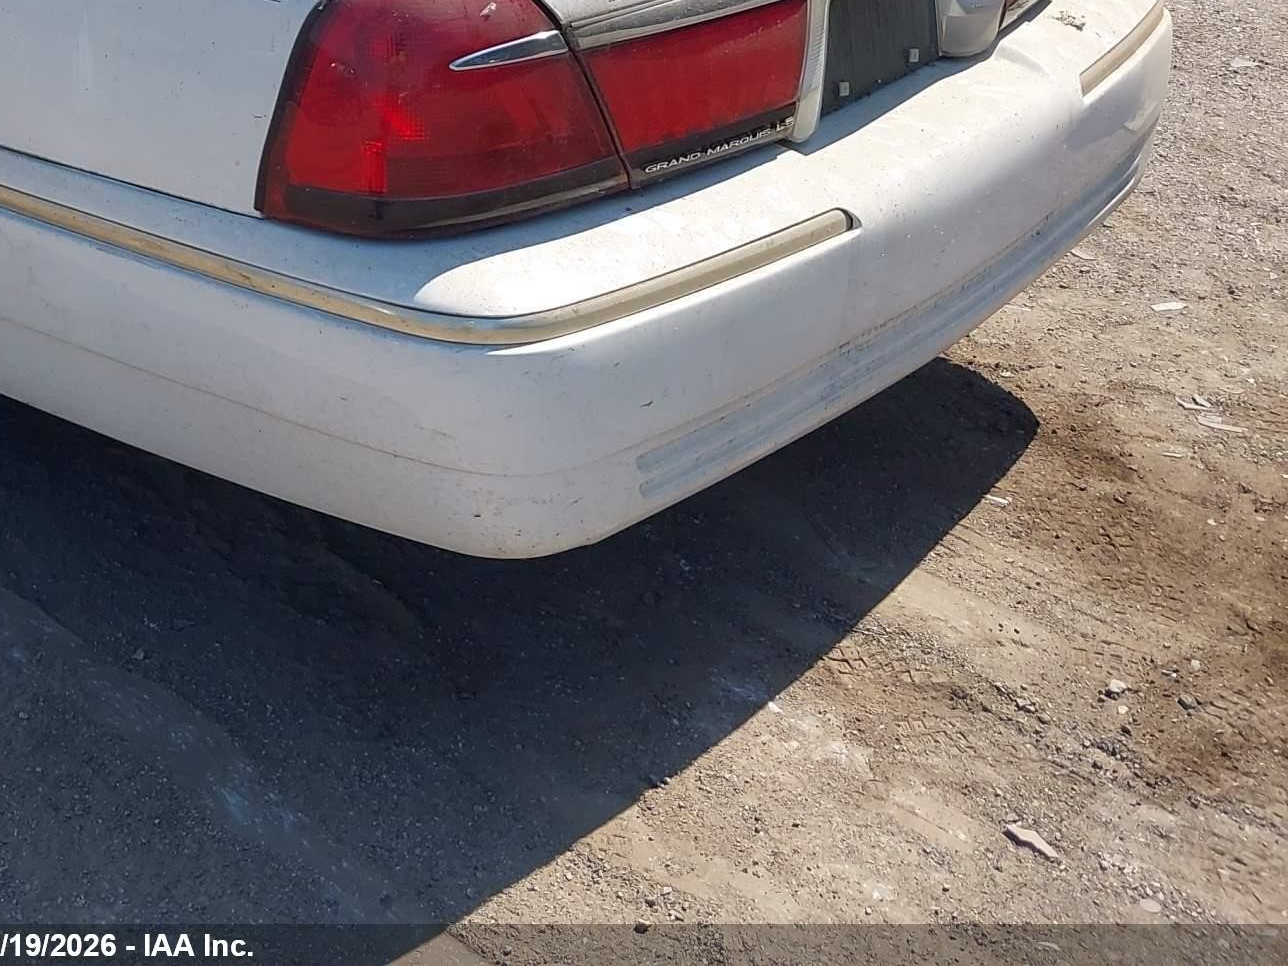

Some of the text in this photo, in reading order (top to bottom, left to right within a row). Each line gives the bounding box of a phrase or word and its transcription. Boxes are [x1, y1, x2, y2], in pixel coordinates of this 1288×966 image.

[645, 116, 795, 173] GRAND MARQUIS LS
